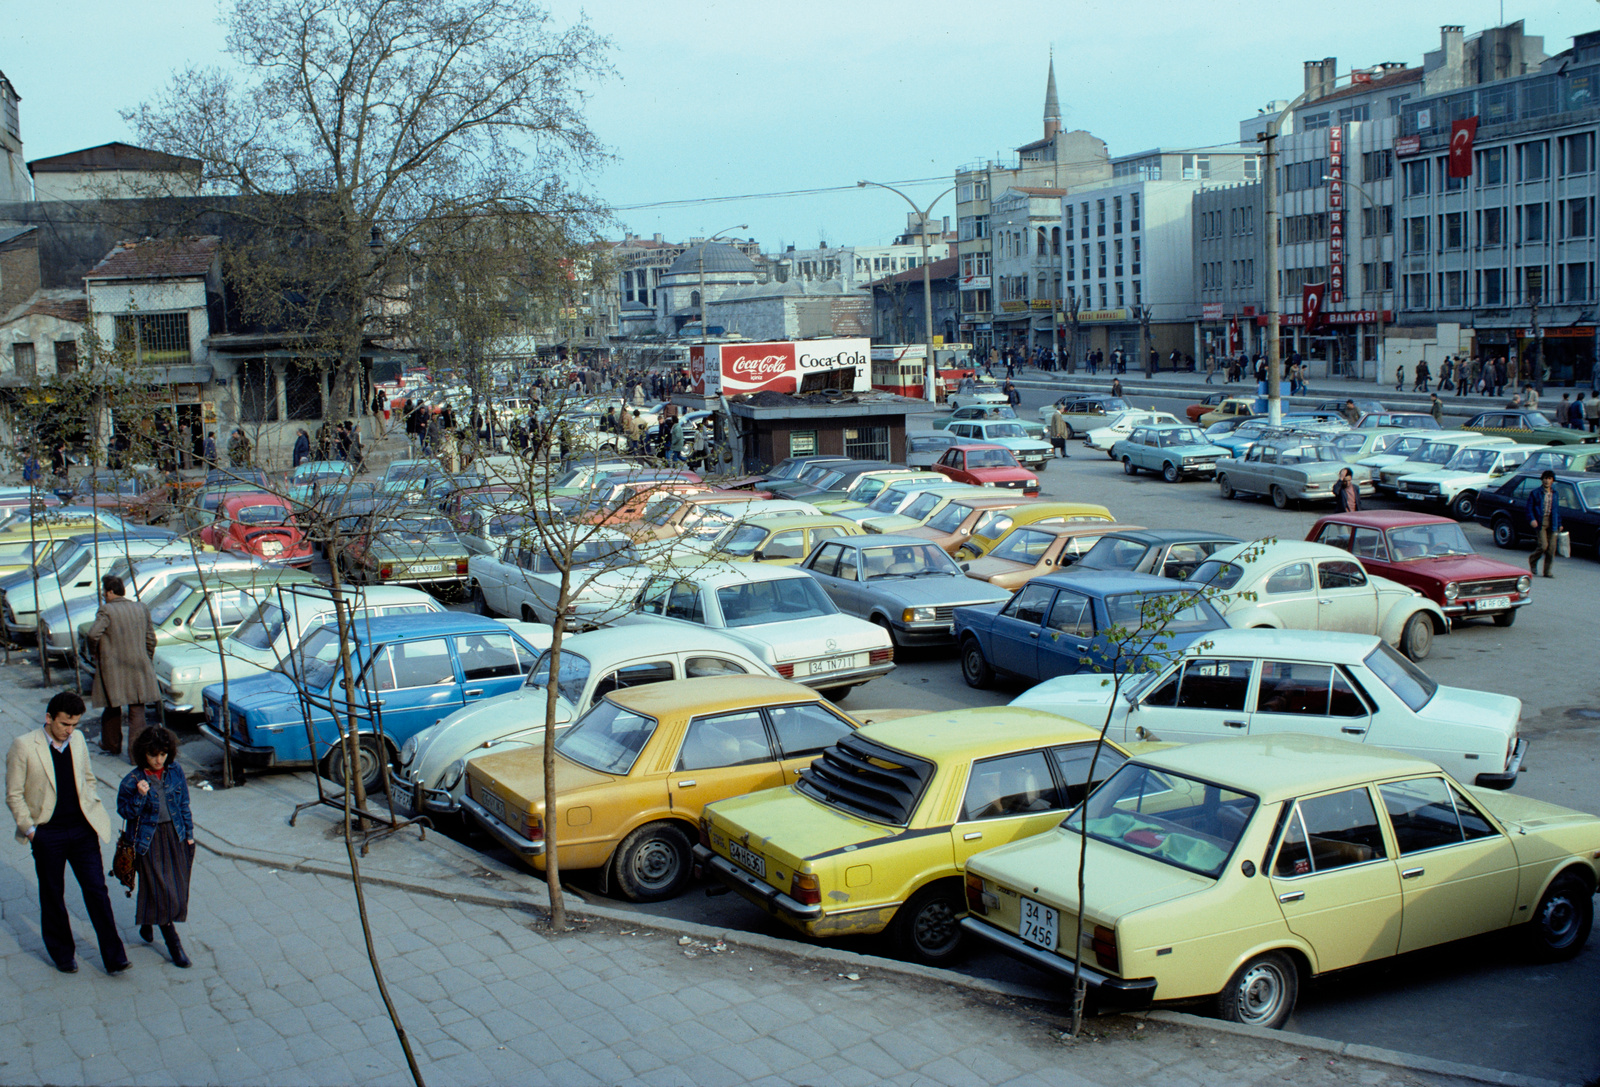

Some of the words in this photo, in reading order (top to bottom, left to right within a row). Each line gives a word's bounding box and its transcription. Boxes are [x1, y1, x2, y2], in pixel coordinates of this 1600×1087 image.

[1331, 212, 1342, 302] BANKASI
[1329, 312, 1375, 323] BANKASI
[733, 355, 788, 374] Coca-Cola
[799, 351, 867, 368] Coca-Cola
[1026, 902, 1039, 921] 34
[1046, 910, 1053, 927] R
[1024, 920, 1053, 946] 7456
